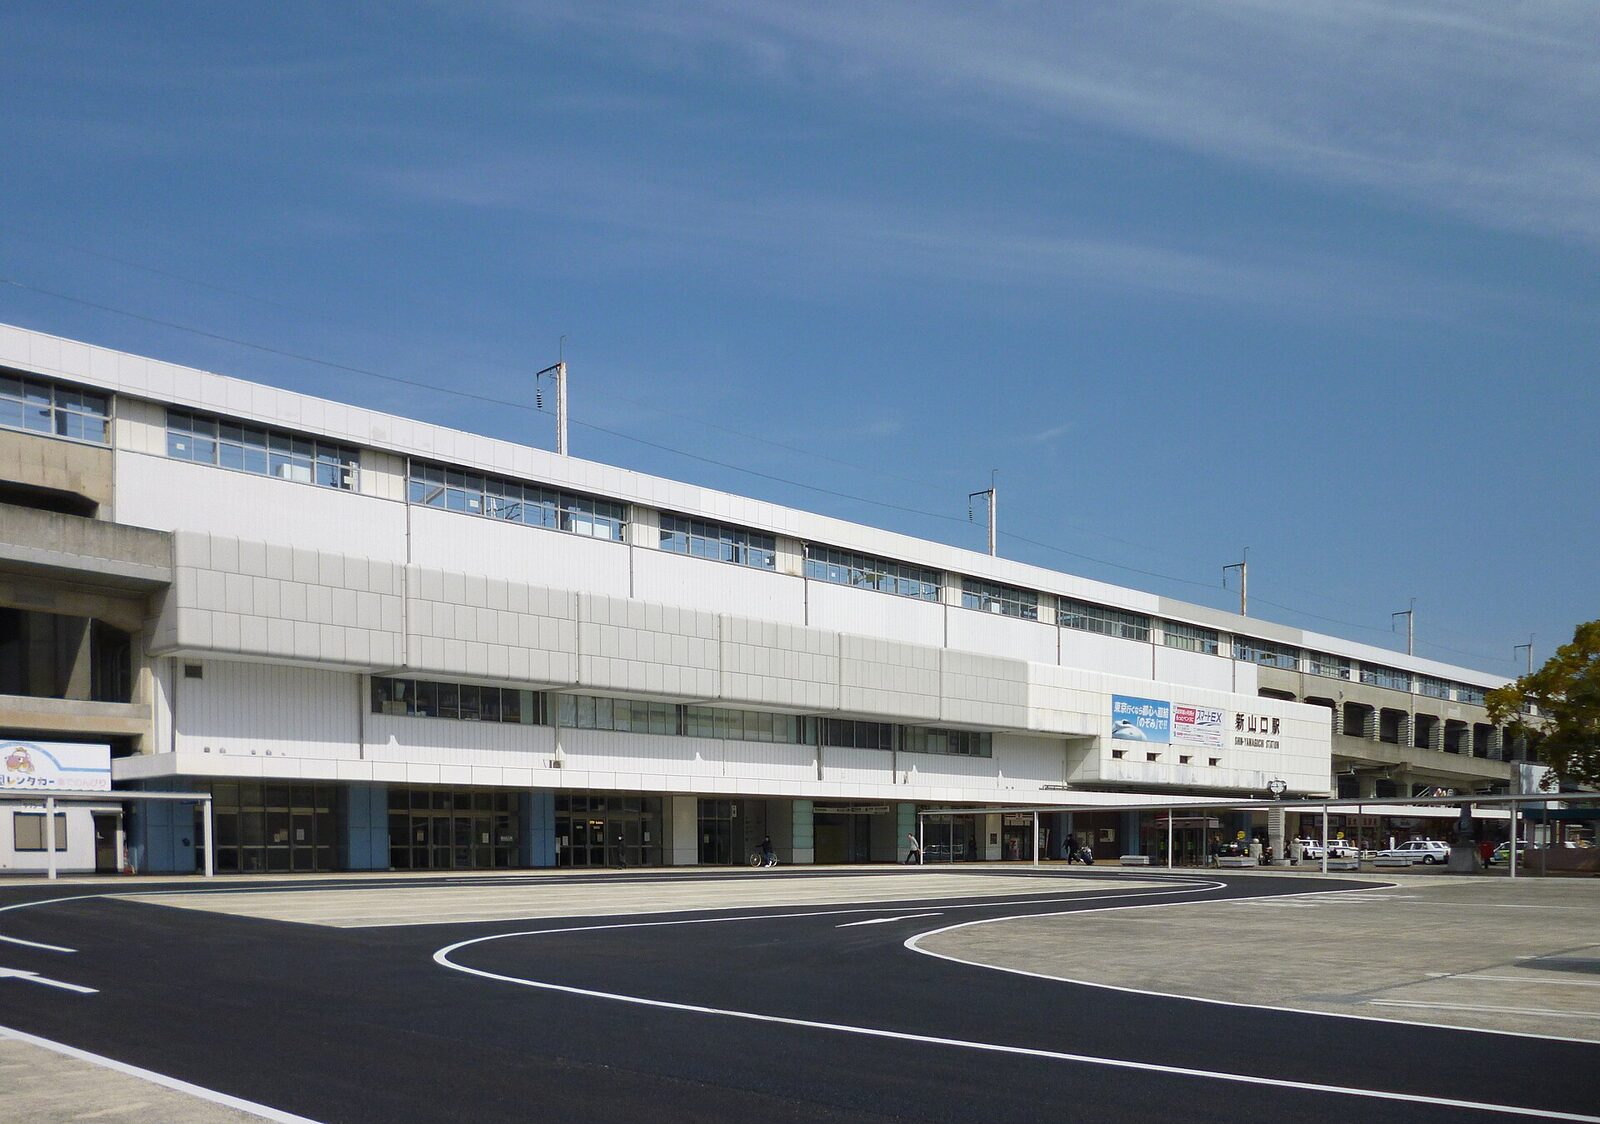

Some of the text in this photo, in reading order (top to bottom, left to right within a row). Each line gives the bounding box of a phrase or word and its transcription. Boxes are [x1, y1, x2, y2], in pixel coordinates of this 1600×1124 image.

[1235, 712, 1280, 735] 新山口駅
[1234, 736, 1264, 748] SHIN-YAMAGUCHI
[1265, 739, 1280, 749] STATION
